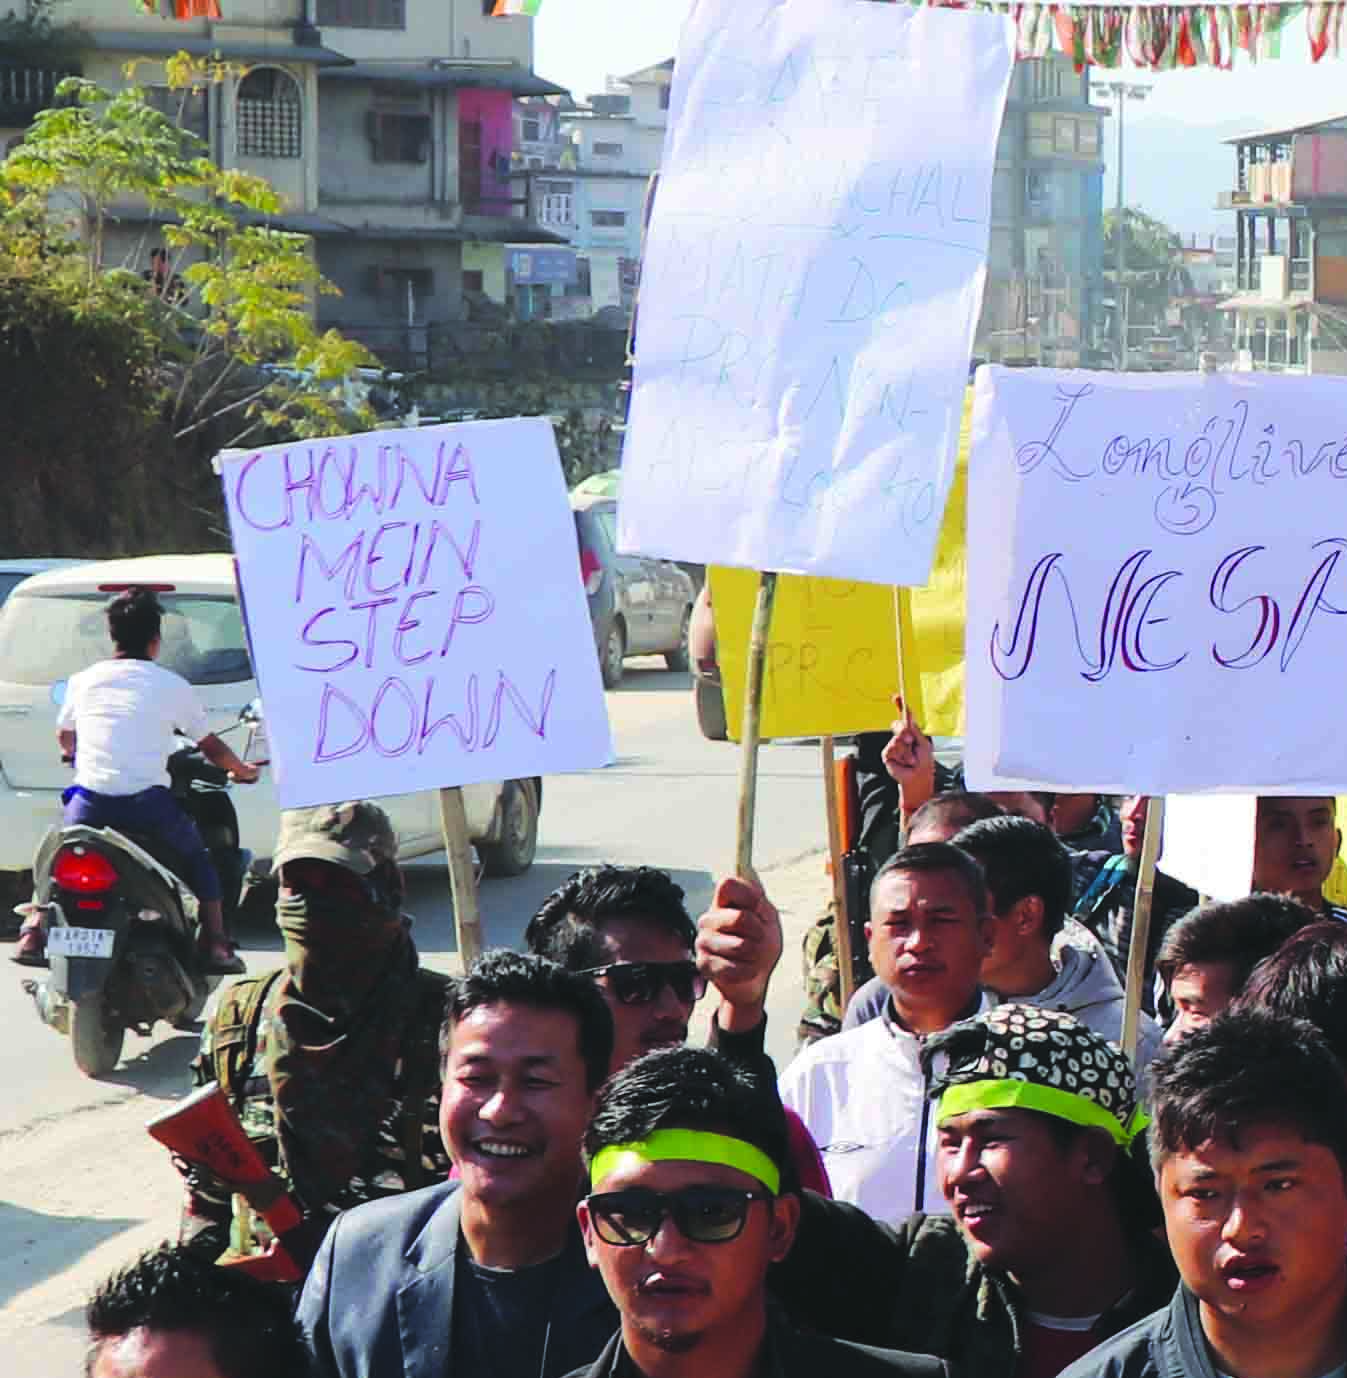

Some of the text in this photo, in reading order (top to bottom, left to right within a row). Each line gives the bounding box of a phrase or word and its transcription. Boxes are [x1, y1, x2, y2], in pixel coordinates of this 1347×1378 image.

[235, 440, 481, 532] CHOWNA
[295, 519, 482, 603] MEIN
[294, 584, 496, 673] STEP
[311, 667, 557, 764] DOWN
